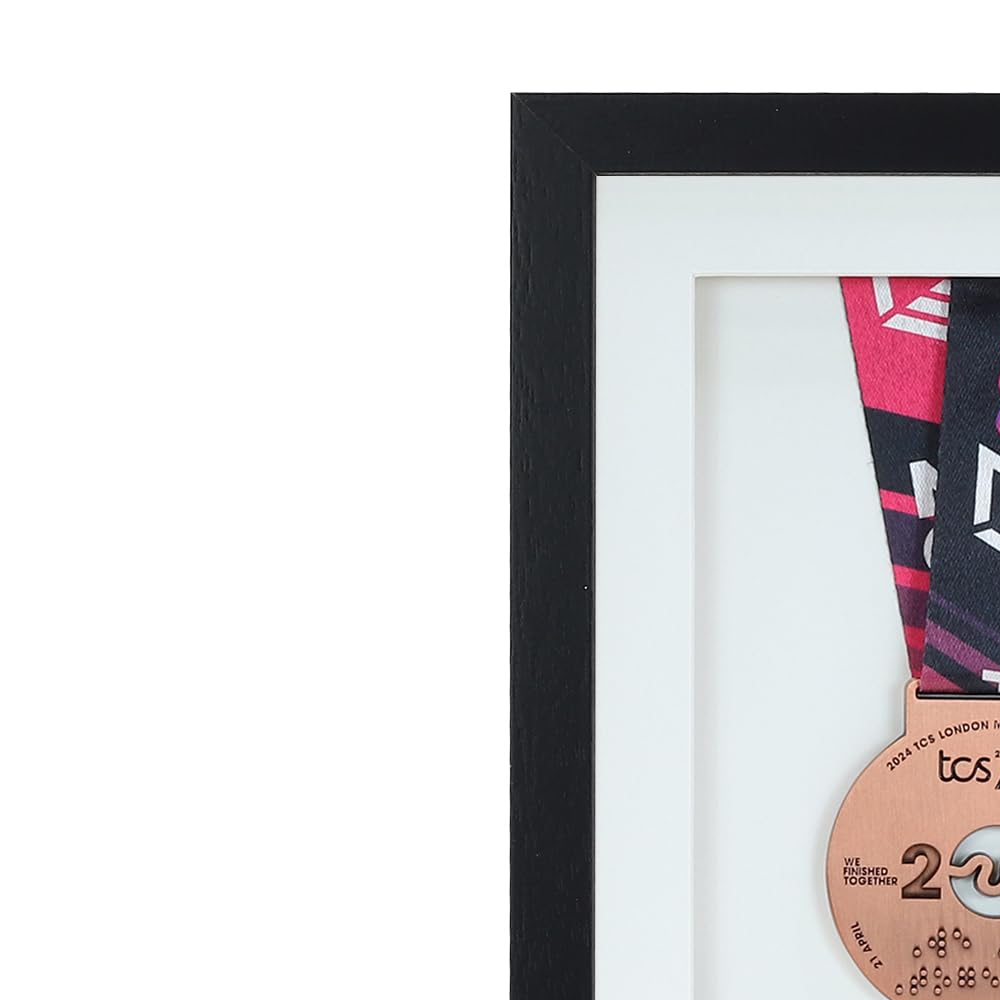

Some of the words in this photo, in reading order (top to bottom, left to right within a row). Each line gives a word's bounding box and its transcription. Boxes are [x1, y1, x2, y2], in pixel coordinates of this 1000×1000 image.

[886, 747, 912, 771] 2024
[913, 734, 936, 752] TCS
[938, 720, 989, 740] LONDON
[938, 749, 992, 783] tcs
[843, 857, 861, 866] WE
[843, 866, 888, 876] FINISHED
[843, 876, 898, 886] TOGETHER
[850, 921, 872, 953] APRIL
[869, 955, 884, 969] 21
